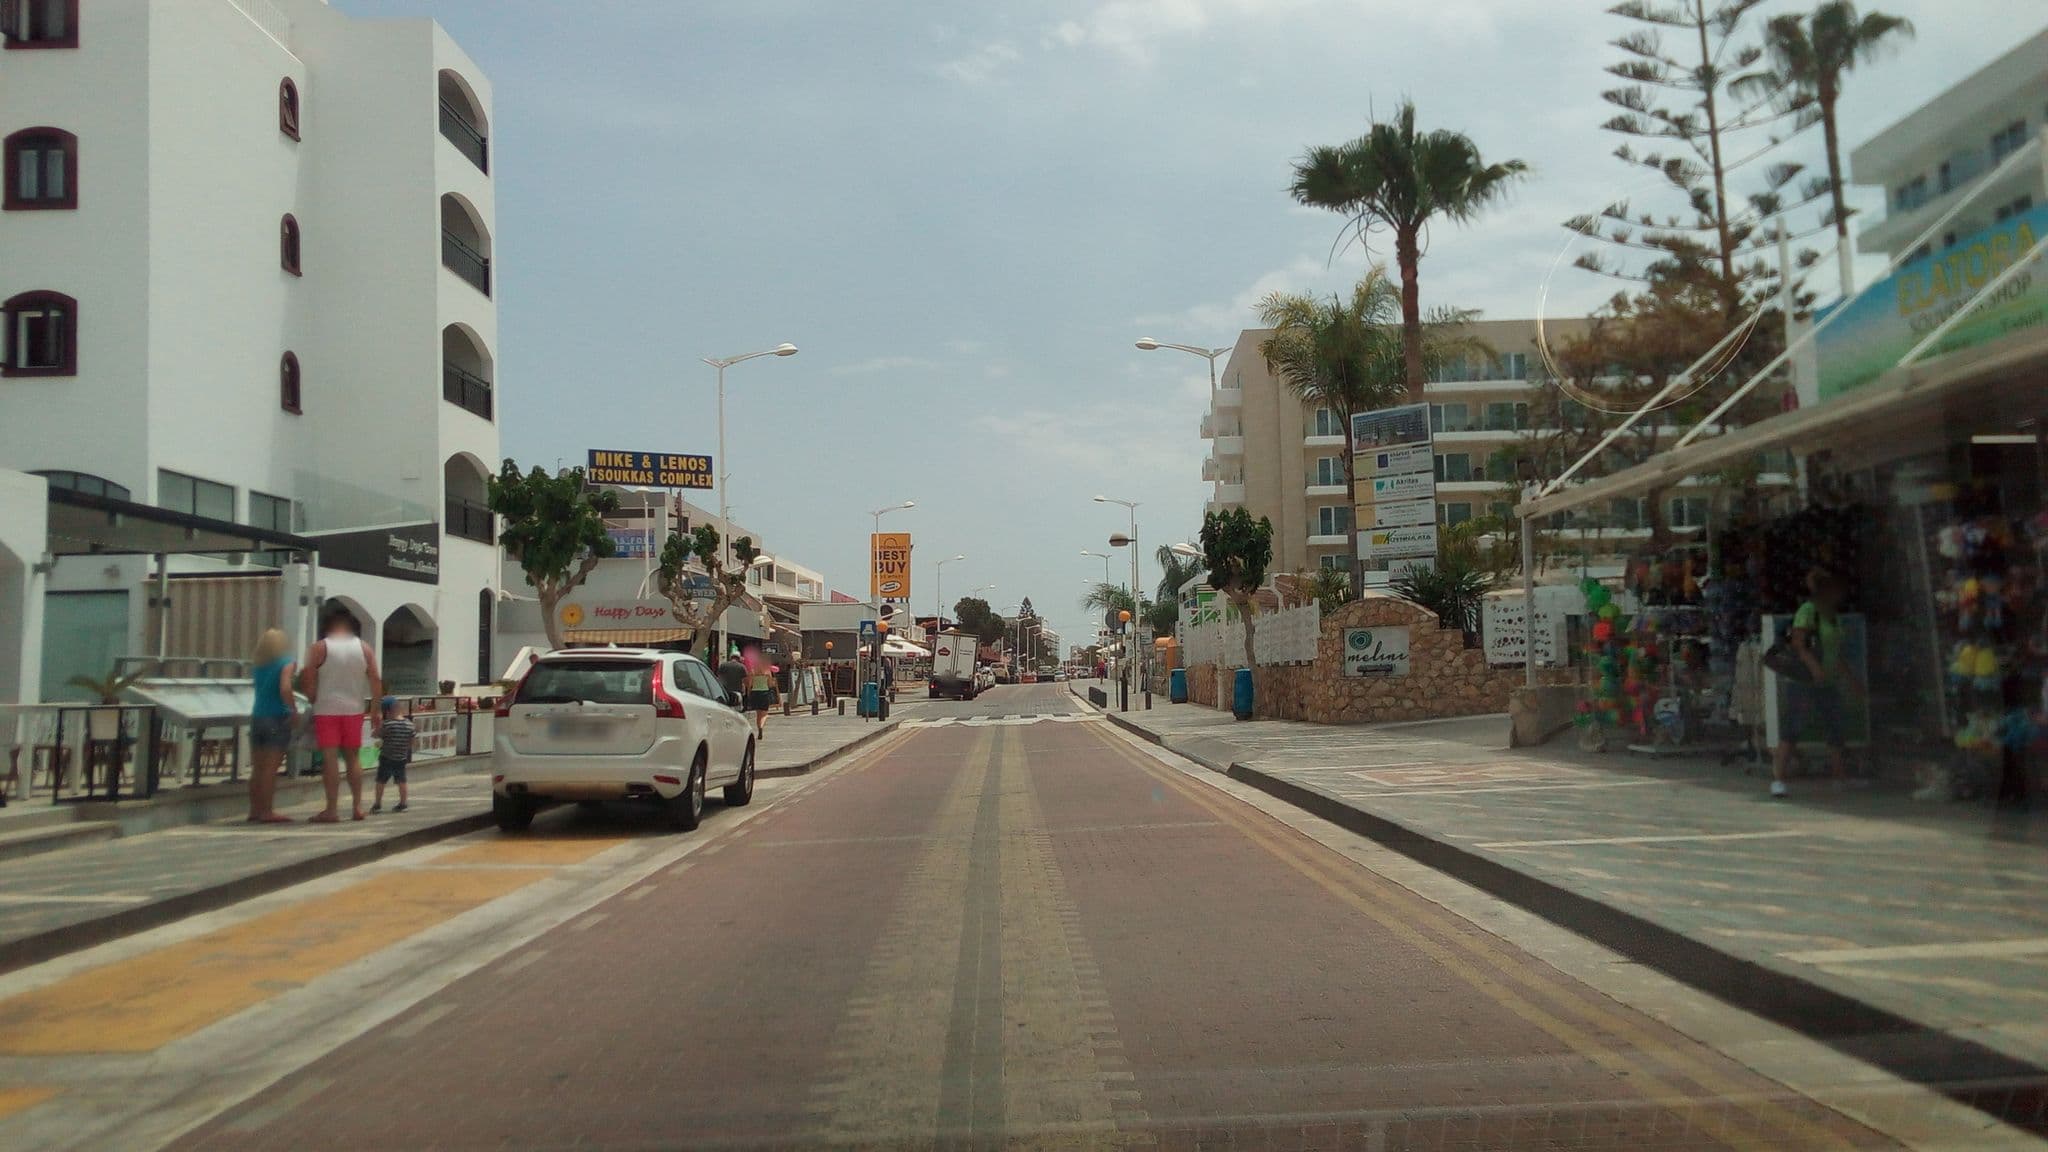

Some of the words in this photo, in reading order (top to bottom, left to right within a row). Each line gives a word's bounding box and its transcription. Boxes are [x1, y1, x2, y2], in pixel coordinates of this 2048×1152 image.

[595, 451, 634, 468] MIKE
[642, 454, 652, 468] &
[659, 455, 708, 472] LENOS
[589, 467, 654, 484] TSOUKKAS
[659, 472, 713, 487] COMPLEX
[874, 551, 907, 560] BEST
[874, 561, 906, 574] BUY
[594, 607, 634, 620] Happy
[635, 606, 666, 619] Days
